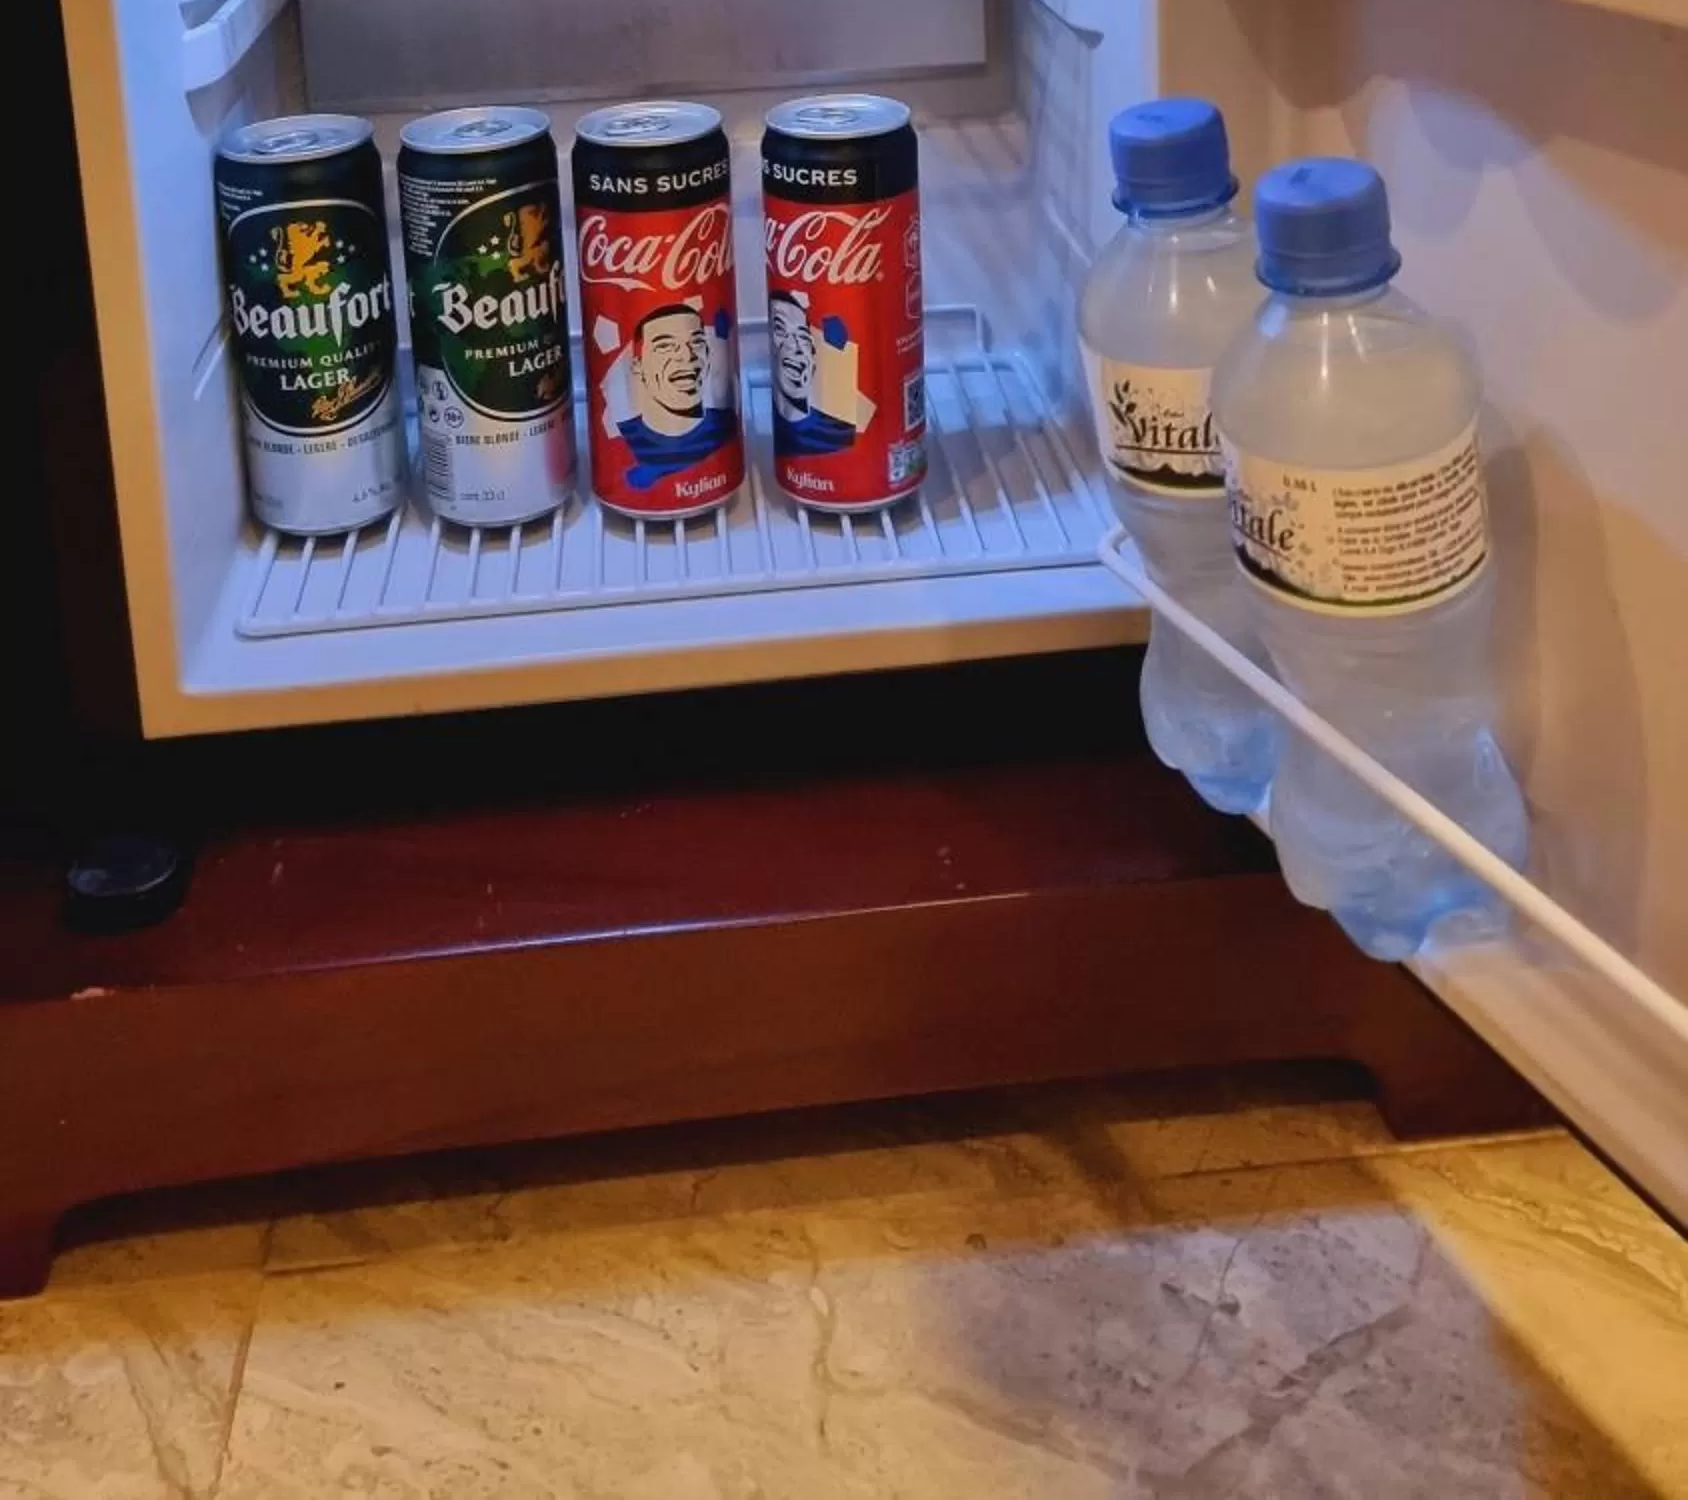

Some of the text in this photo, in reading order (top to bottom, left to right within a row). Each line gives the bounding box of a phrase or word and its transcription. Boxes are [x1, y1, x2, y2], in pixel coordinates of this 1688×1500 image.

[589, 173, 649, 195] SANS
[773, 162, 858, 187] SUCRES
[229, 272, 391, 347] Beaufort
[246, 353, 313, 369] PREMIUM
[464, 339, 540, 361] PREMIUM
[508, 345, 563, 377] LAGER
[674, 473, 727, 499] Kylian
[786, 465, 835, 493] Kylian
